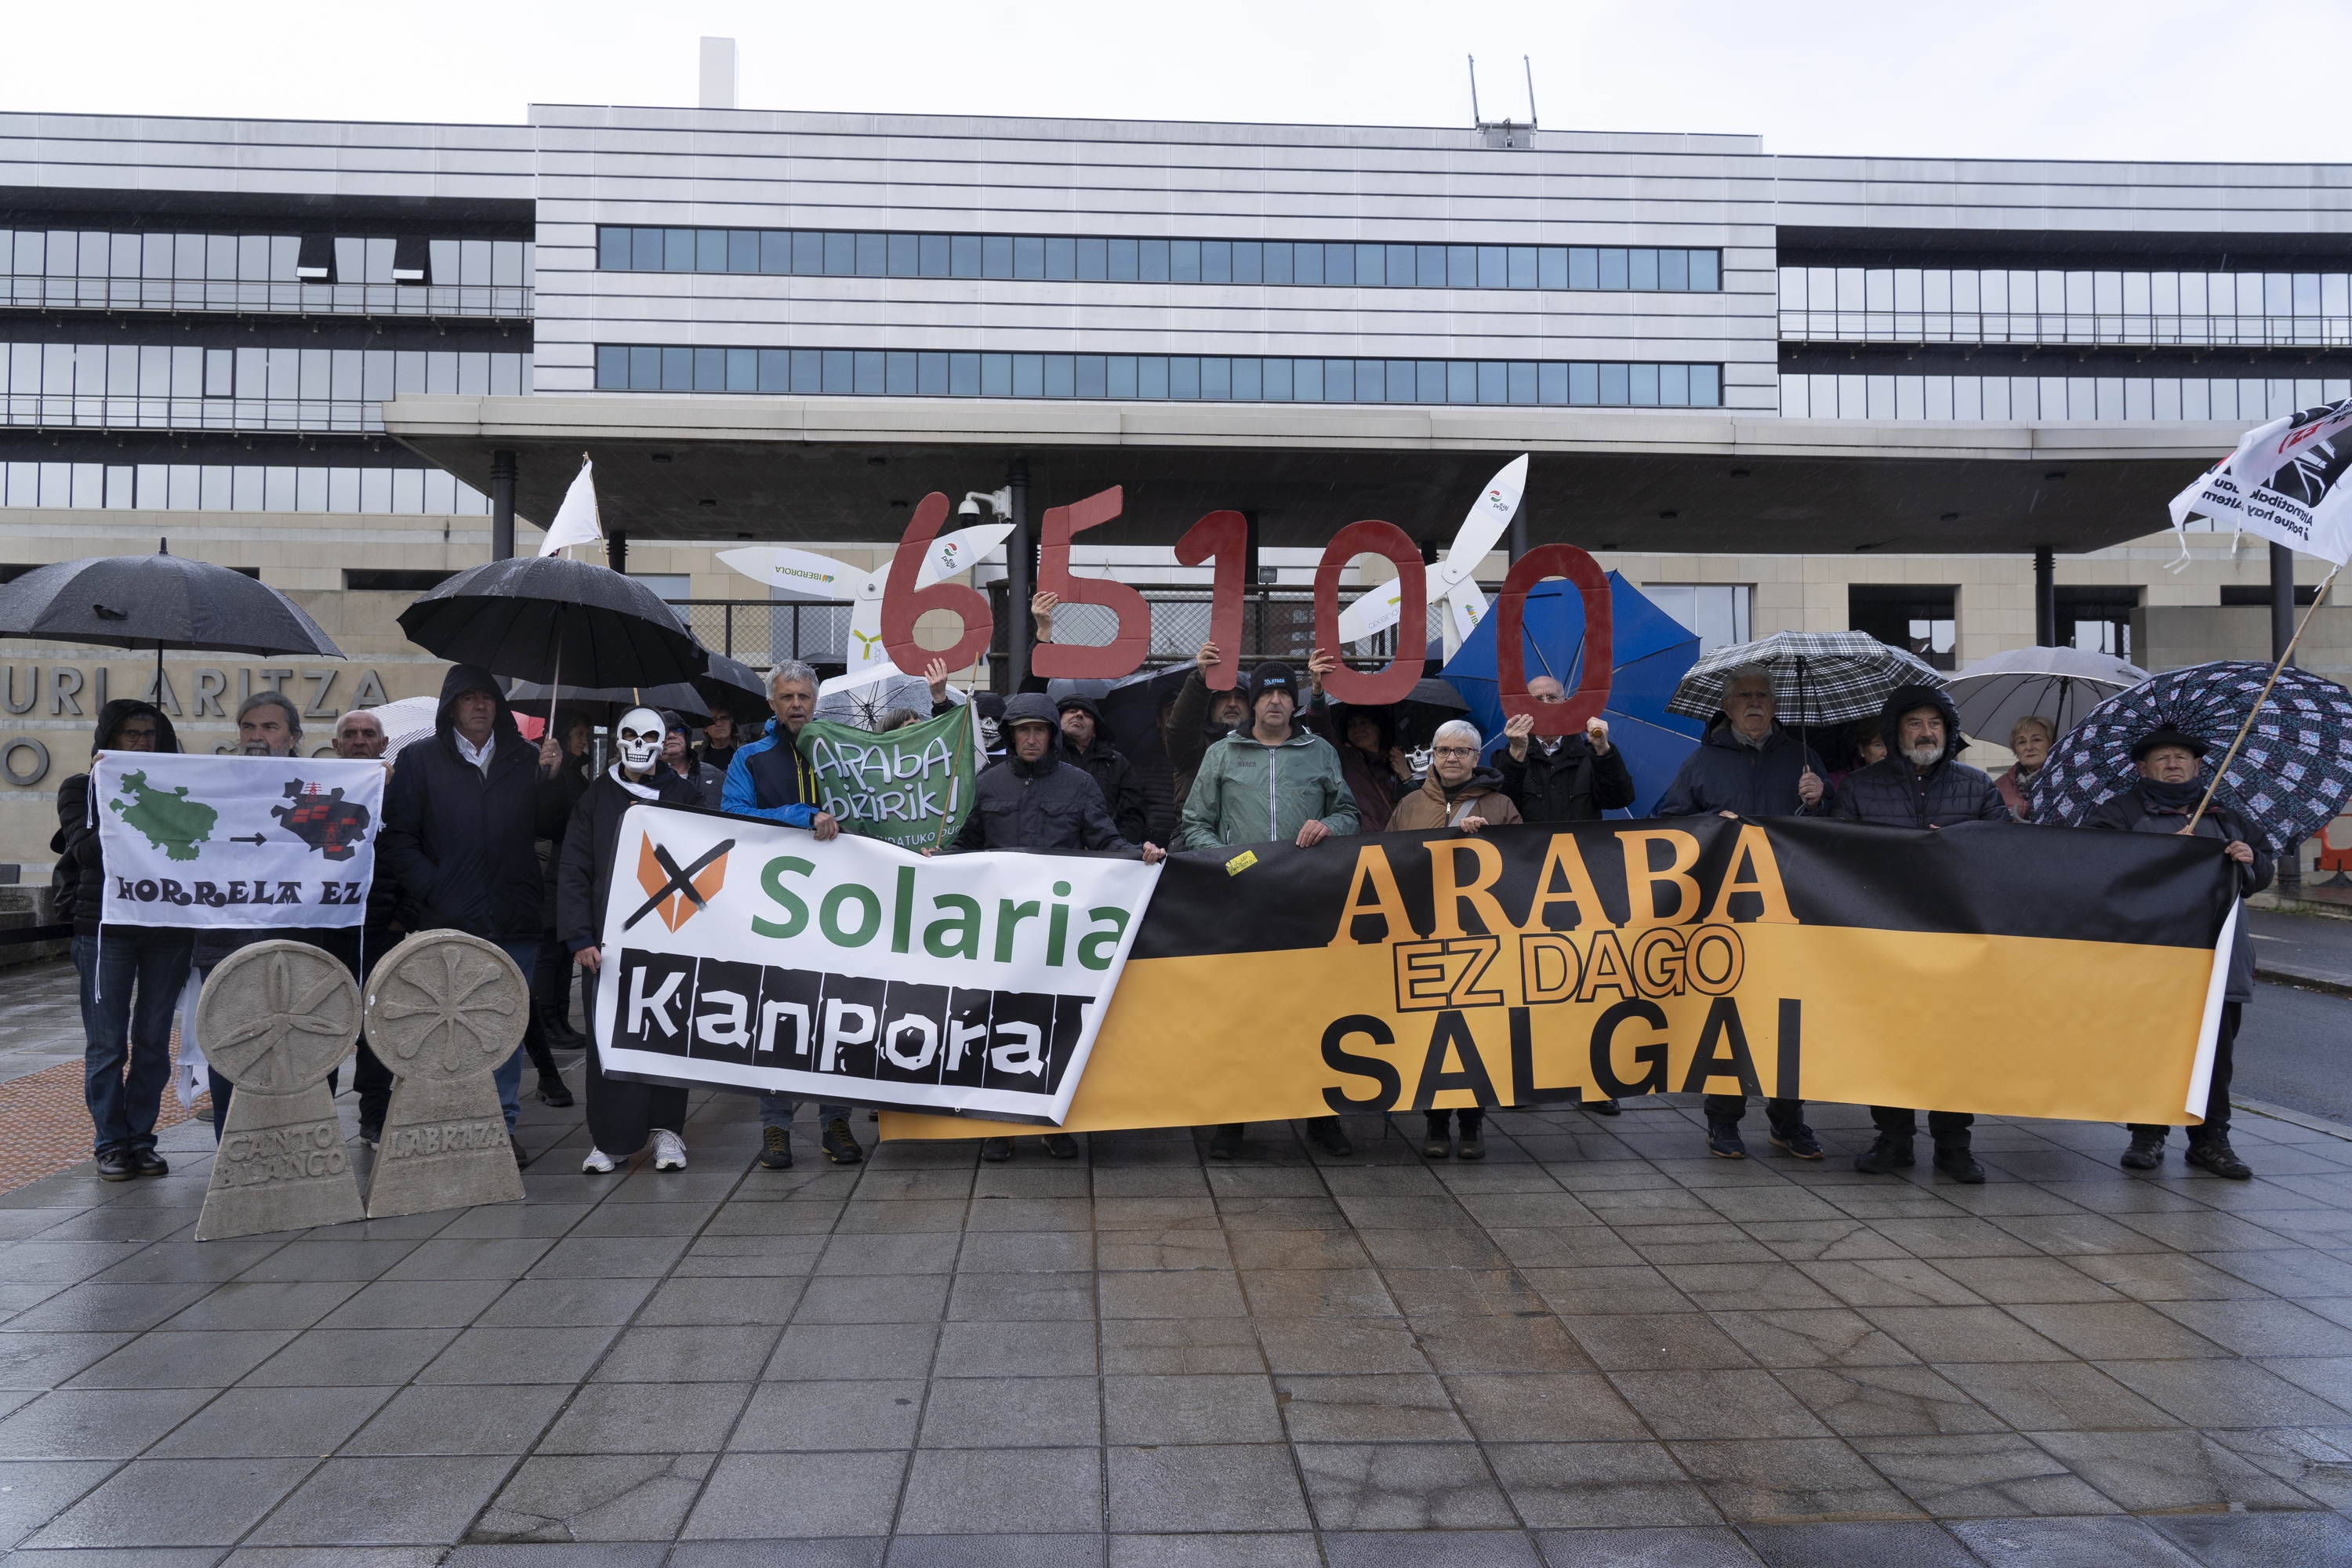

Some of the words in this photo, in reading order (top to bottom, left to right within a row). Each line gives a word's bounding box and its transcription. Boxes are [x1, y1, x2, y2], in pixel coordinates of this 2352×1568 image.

[775, 565, 822, 580] IBERDROLA
[116, 876, 303, 908] HORRELA
[318, 881, 363, 905] EZ
[1327, 823, 1800, 948] ARABA
[750, 855, 1132, 971] Solaria
[1392, 933, 1504, 1013] EZ
[1519, 924, 1745, 1005] DAGO
[1321, 996, 1802, 1116] SALGAI
[226, 1124, 335, 1162] CANTO
[389, 1121, 509, 1160] LABRAZA
[216, 1149, 347, 1187] BLANCO
